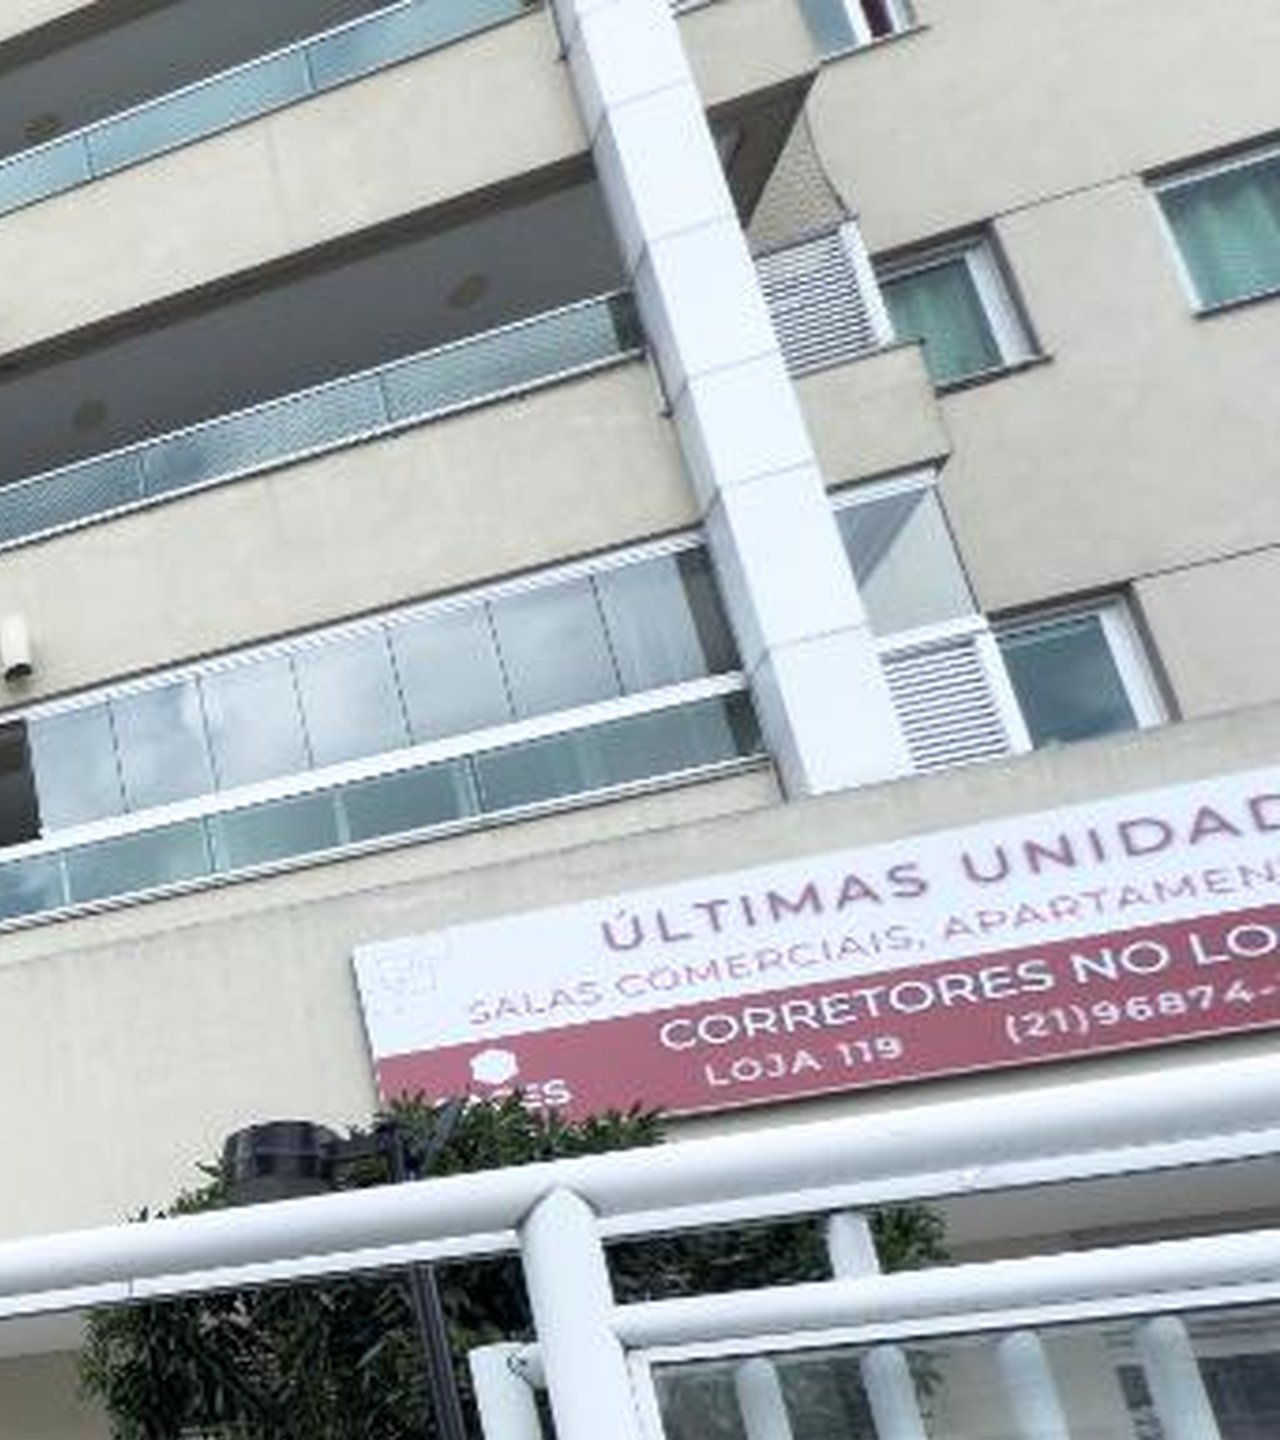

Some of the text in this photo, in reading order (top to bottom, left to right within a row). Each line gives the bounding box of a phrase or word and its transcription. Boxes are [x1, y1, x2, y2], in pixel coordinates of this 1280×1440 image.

[601, 861, 930, 952] ÚLTIMAS
[469, 981, 604, 1026] SALAS
[614, 926, 926, 999] COMERCIAIS,
[659, 923, 1278, 1051] CORRETORES NO LO
[703, 1050, 822, 1087] LOJA
[836, 1036, 904, 1067] 119
